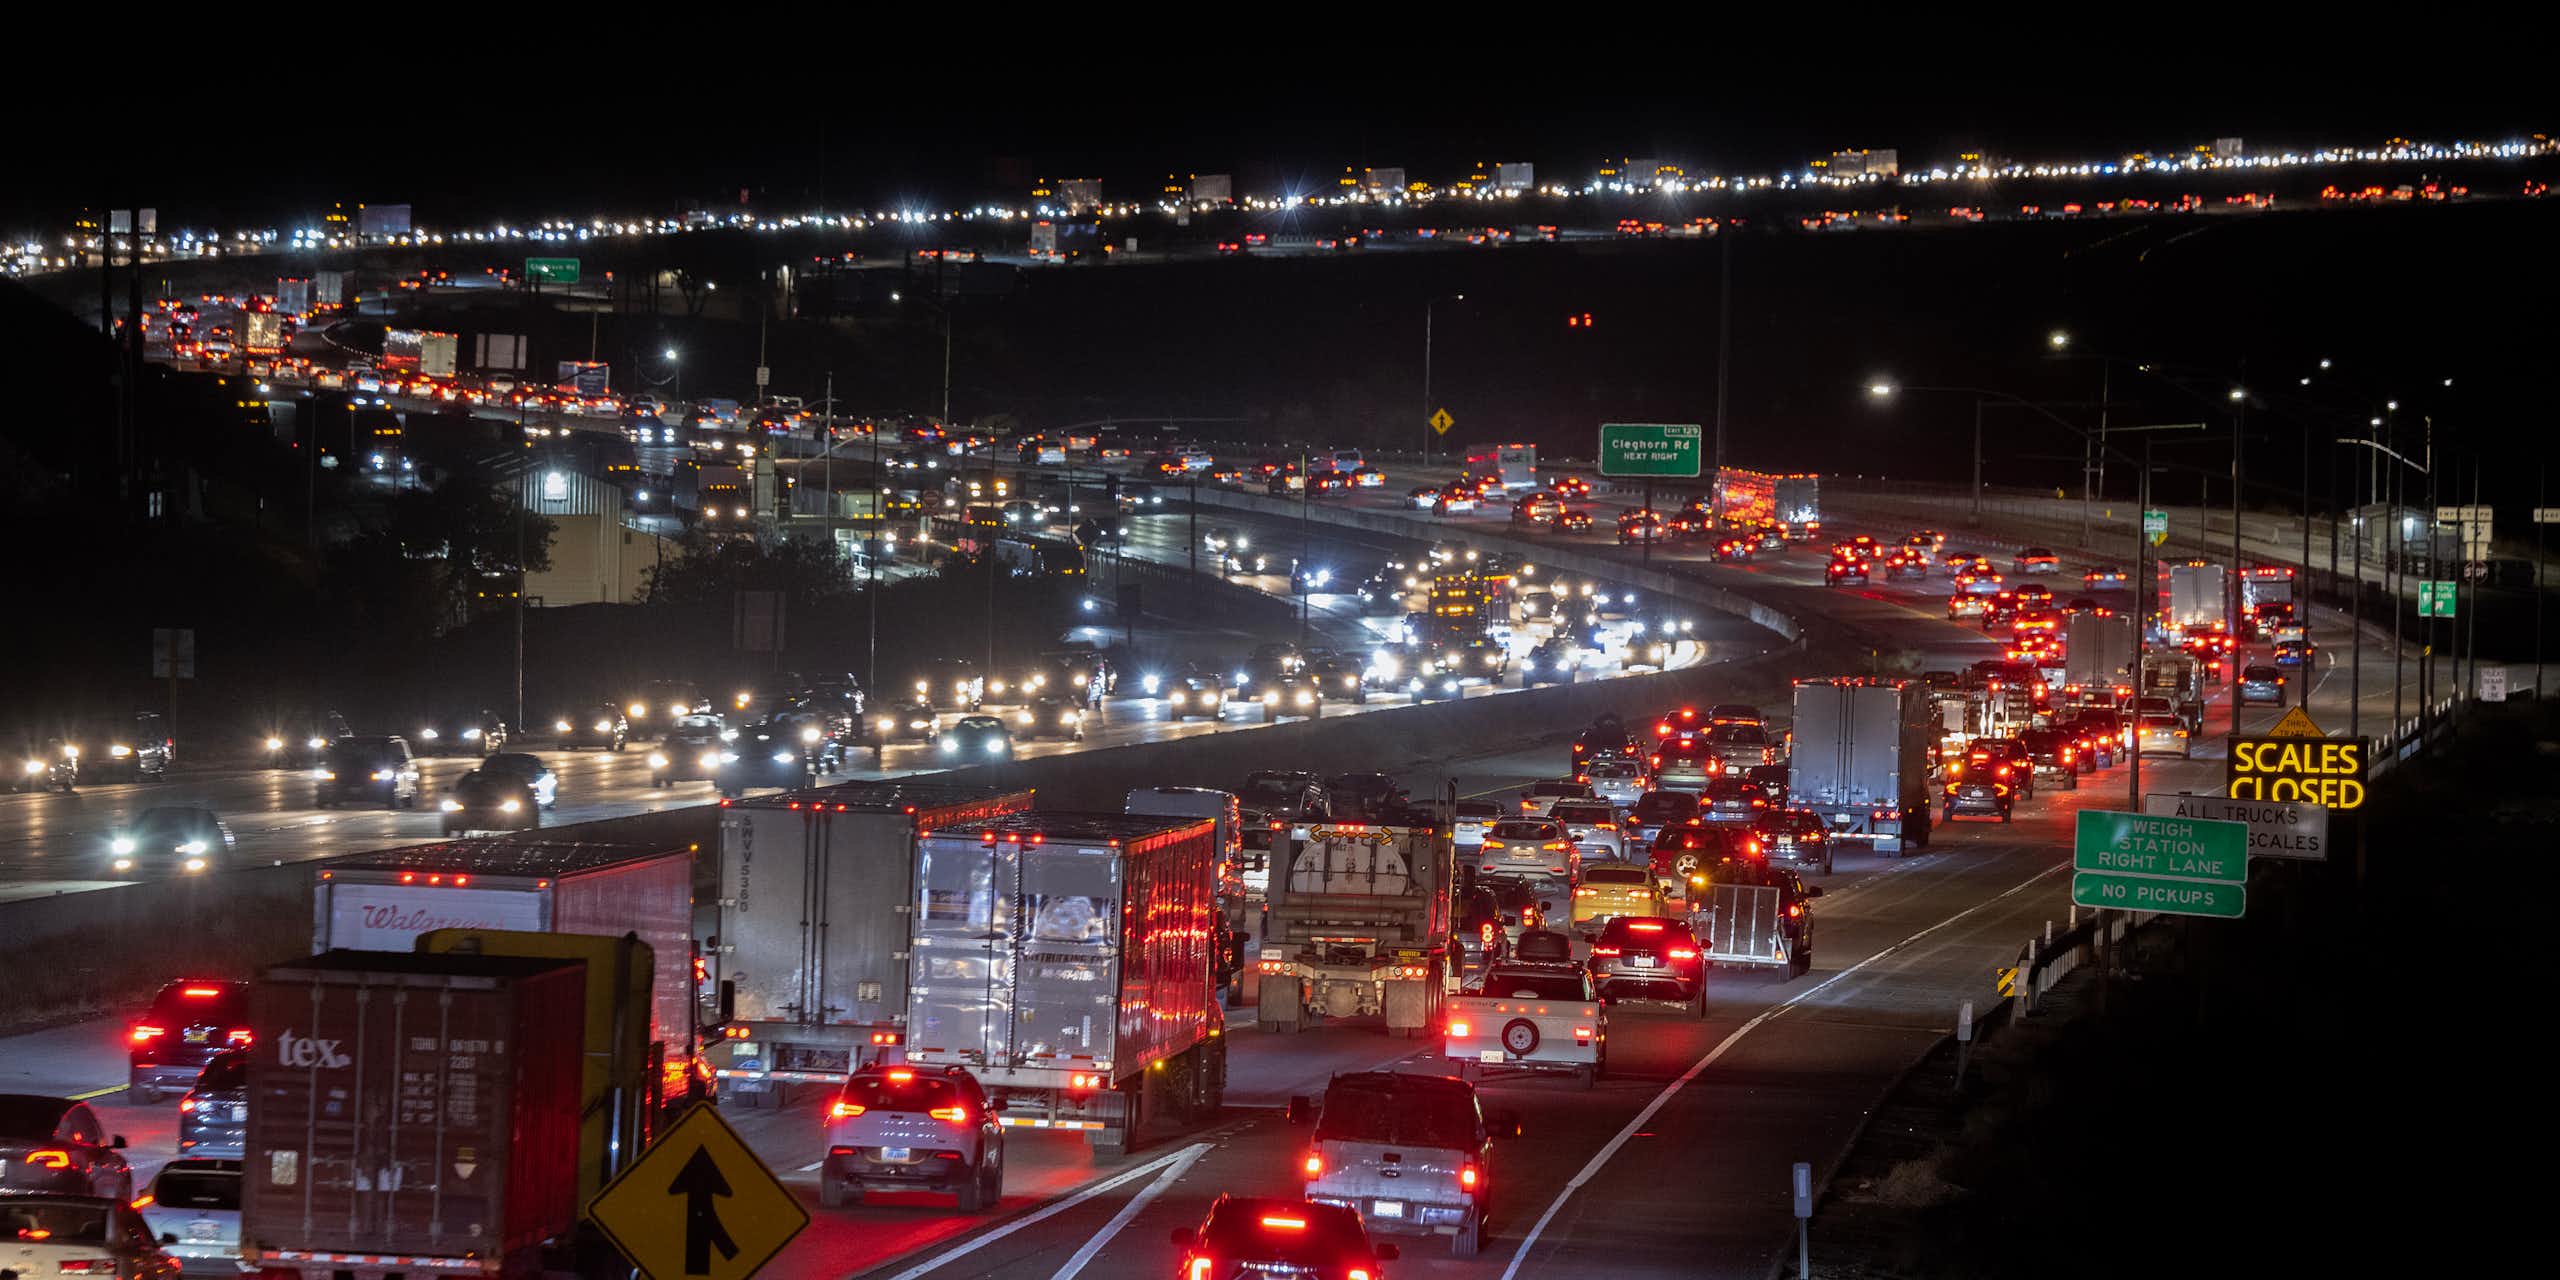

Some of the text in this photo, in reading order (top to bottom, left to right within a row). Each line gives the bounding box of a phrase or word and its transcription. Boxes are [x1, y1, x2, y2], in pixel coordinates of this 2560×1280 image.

[1612, 440, 1690, 451] Cleghorn Rd
[1623, 452, 1678, 461] NEXT RIGHT
[2464, 567, 2488, 577] SOP
[2235, 742, 2358, 774] SCALES
[2230, 777, 2364, 809] CLOSED
[2176, 804, 2298, 824] ALL TRUCKS
[2133, 820, 2193, 838] WEIGH
[2119, 837, 2205, 856] STATION
[2249, 832, 2319, 851] SCALES
[2098, 851, 2223, 875] RIGHT LANE
[2103, 884, 2215, 906] NO PICKUPS
